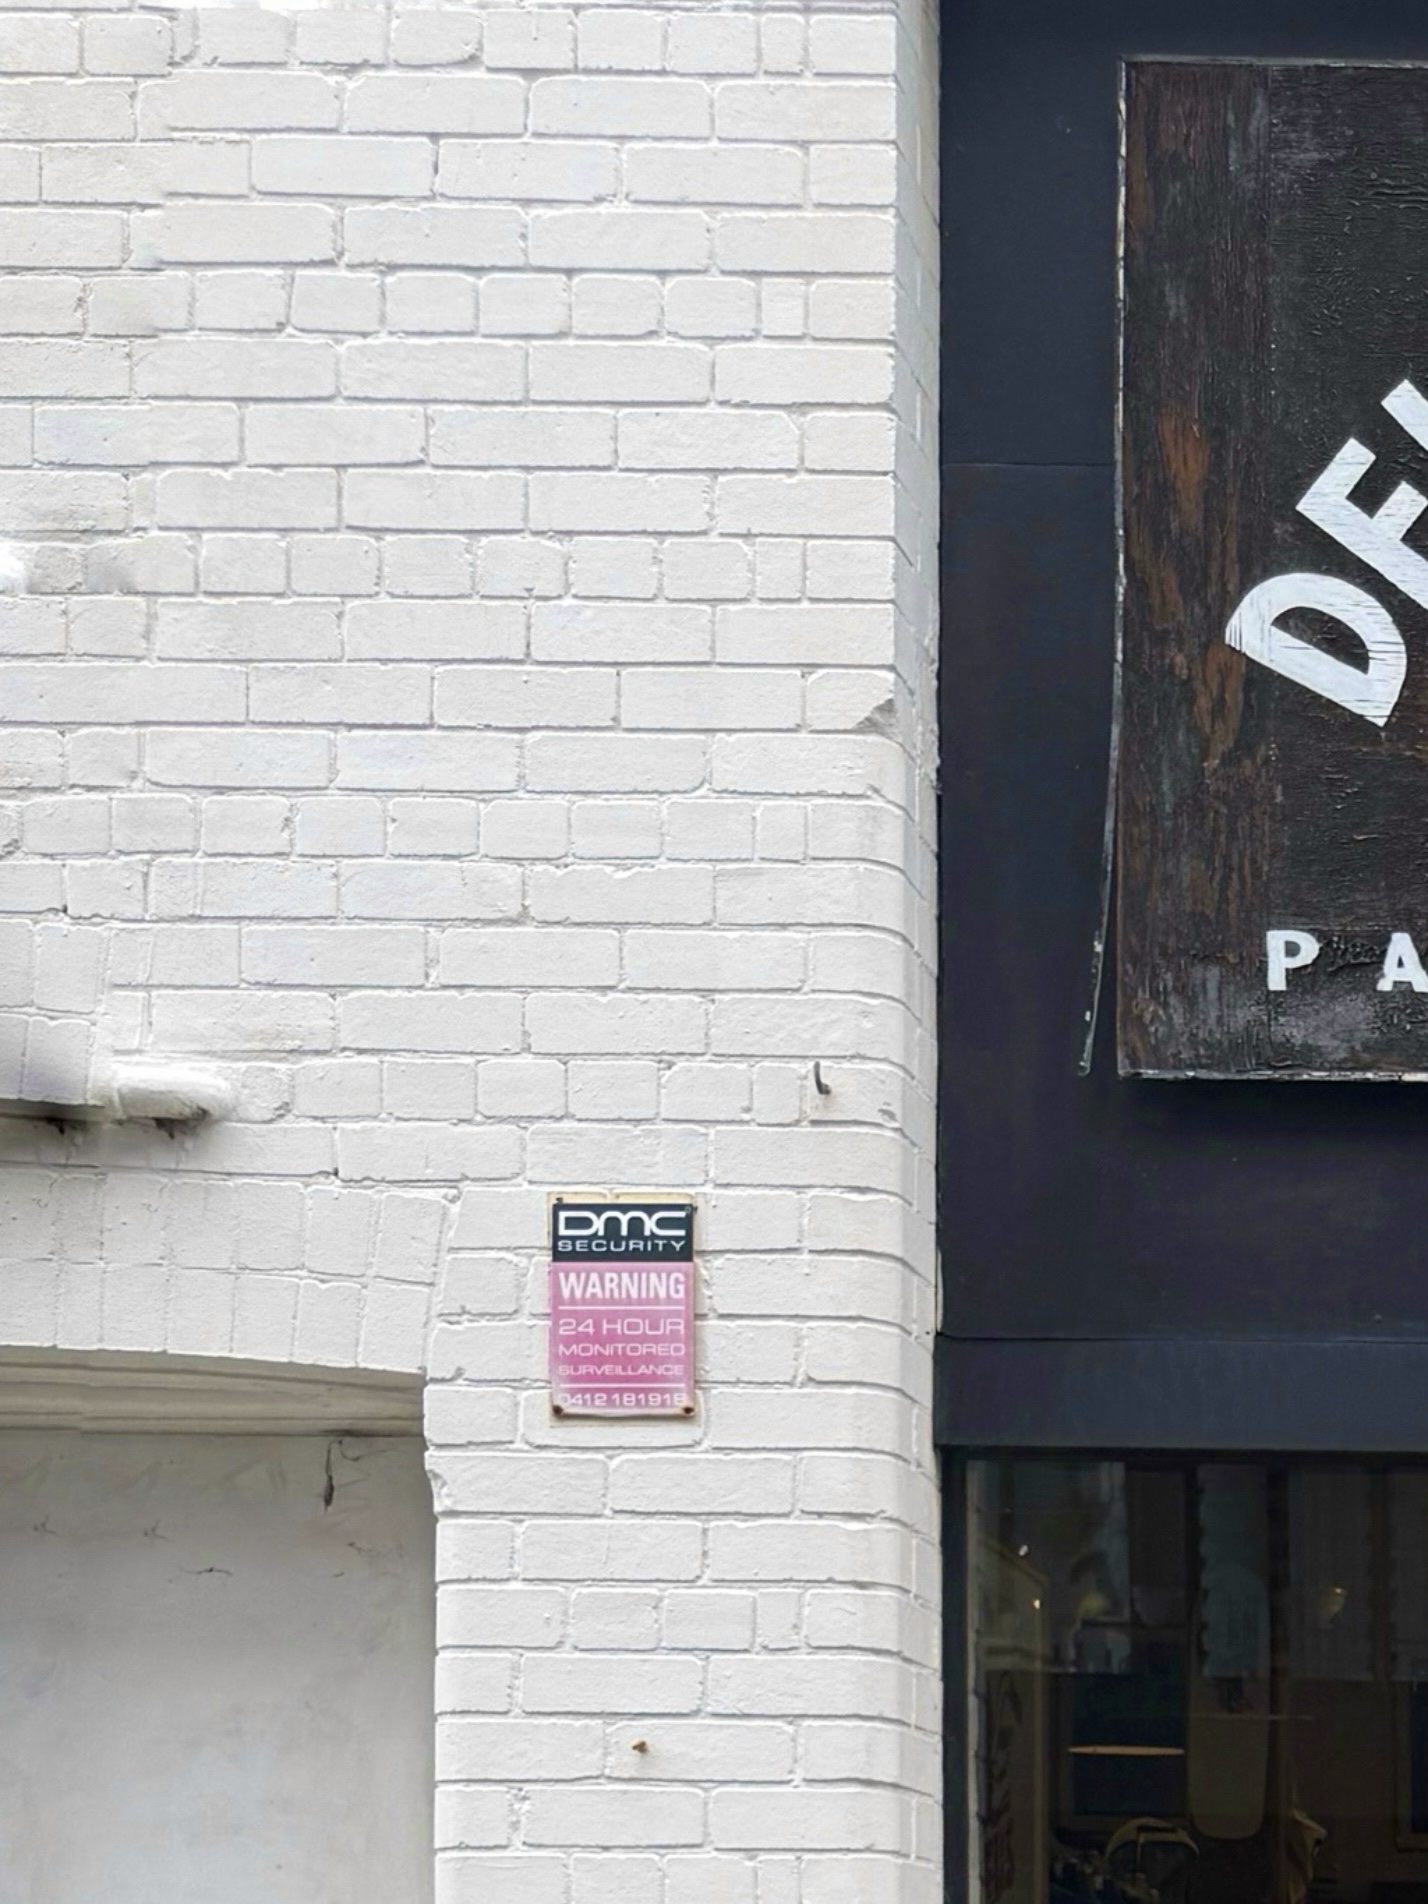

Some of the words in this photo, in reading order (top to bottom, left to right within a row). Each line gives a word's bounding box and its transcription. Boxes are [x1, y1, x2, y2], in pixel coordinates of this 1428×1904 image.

[558, 1240, 686, 1252] SECURITY
[558, 1272, 685, 1299] WARNING
[558, 1318, 596, 1336] 24
[602, 1318, 685, 1336] HOUR
[558, 1342, 685, 1357] MONITORED
[558, 1364, 684, 1376] SURVEILLANCE
